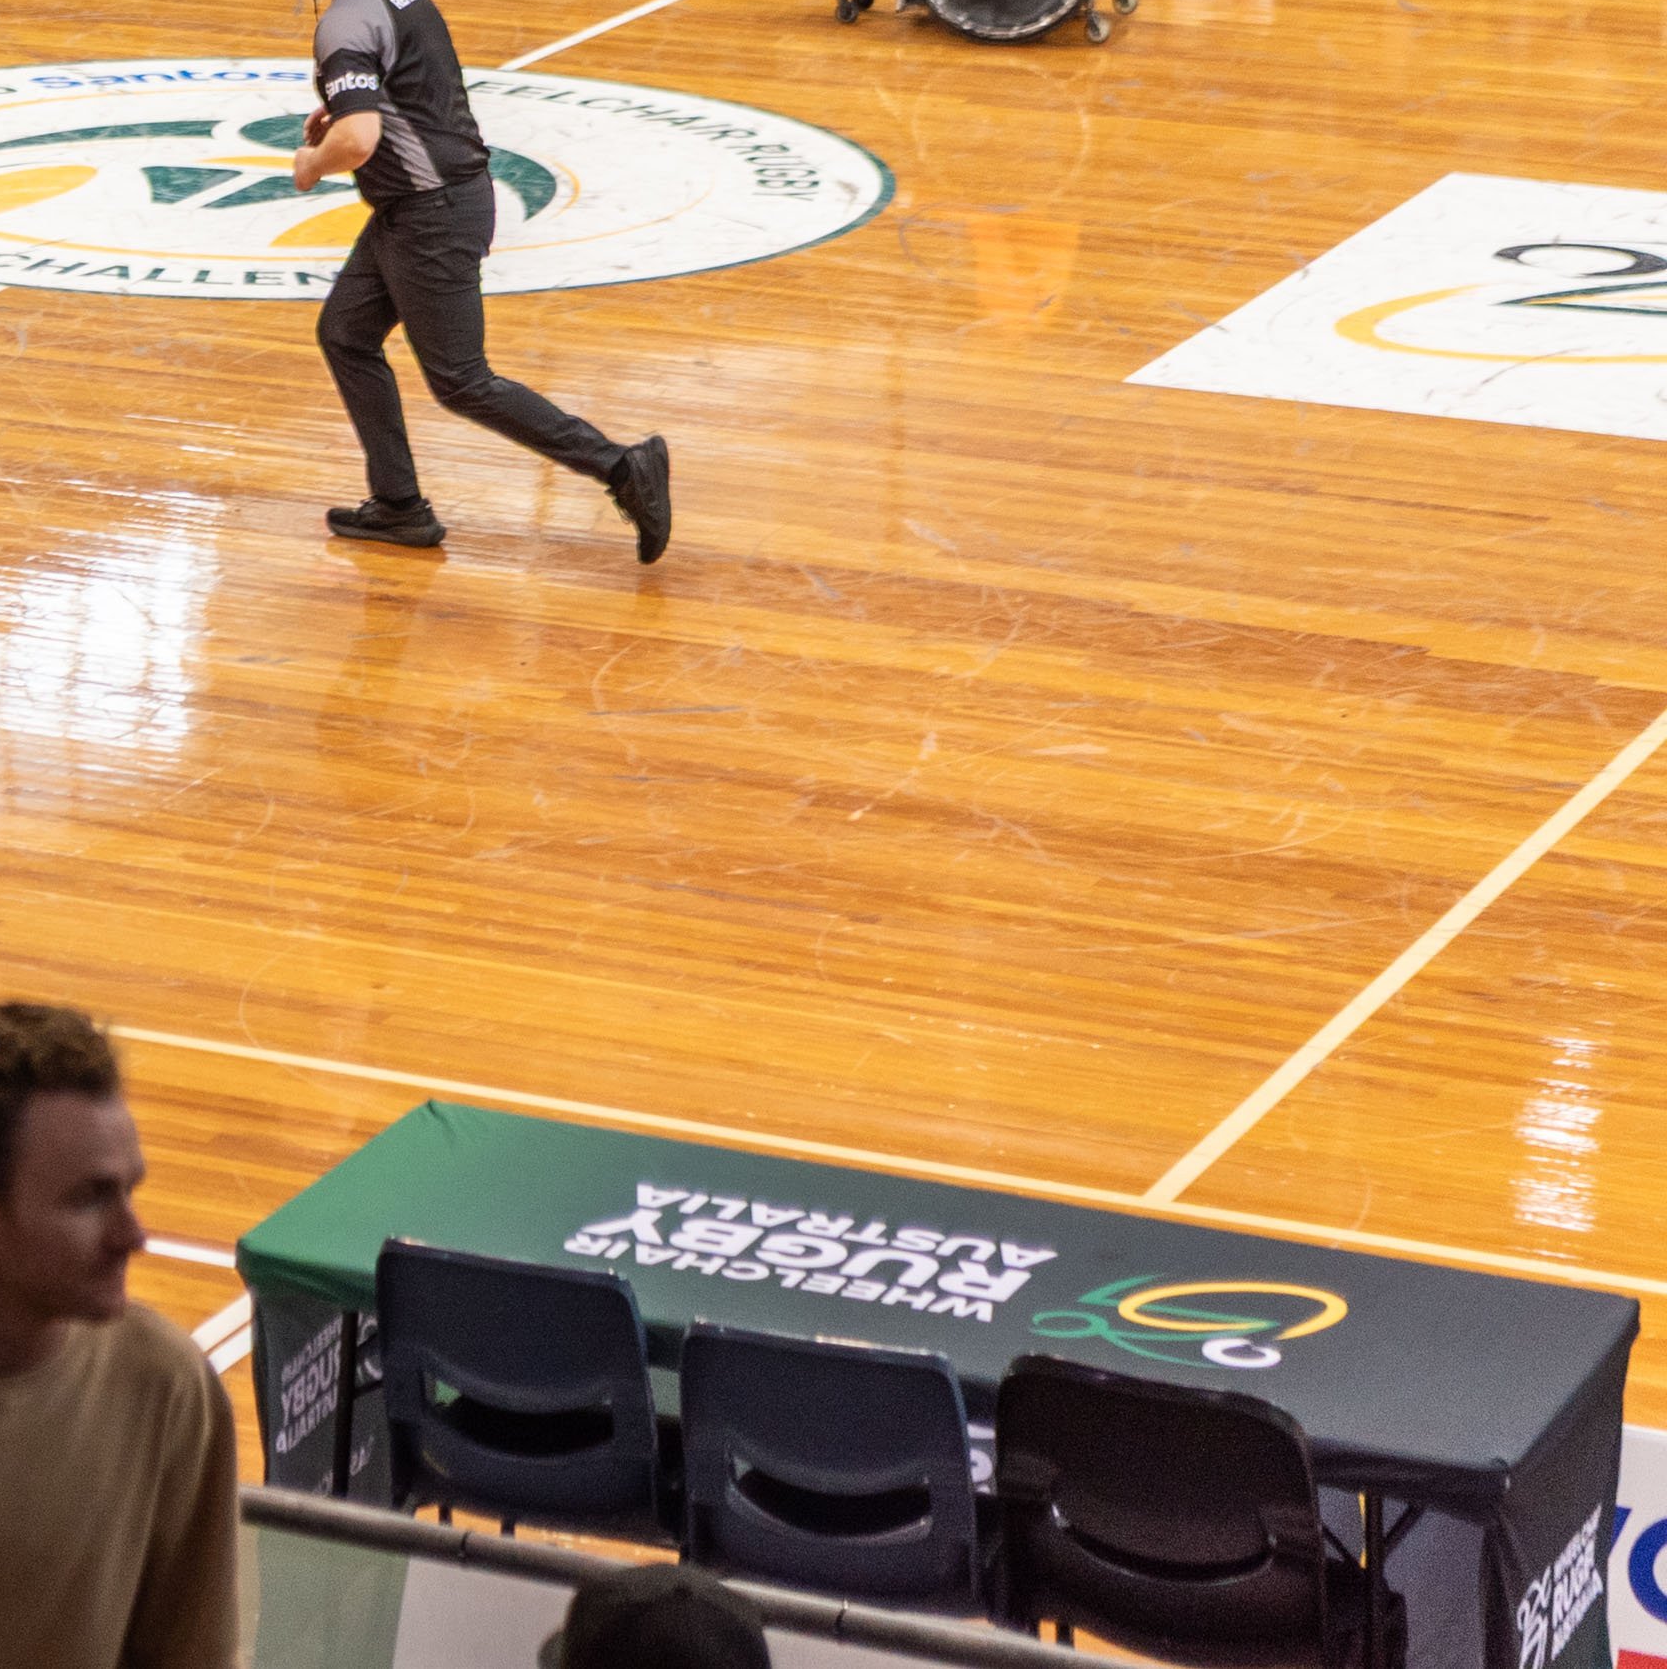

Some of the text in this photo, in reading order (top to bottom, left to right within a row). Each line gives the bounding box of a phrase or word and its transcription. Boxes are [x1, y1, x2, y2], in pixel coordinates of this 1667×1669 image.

[29, 68, 310, 90] Santos
[466, 79, 759, 142] EELCHAIR
[726, 142, 820, 203] RUGBY
[578, 1207, 1032, 1303] RUGBY
[635, 1182, 1060, 1269] AUSTRALIA
[563, 1231, 994, 1323] WHEELCHAIR
